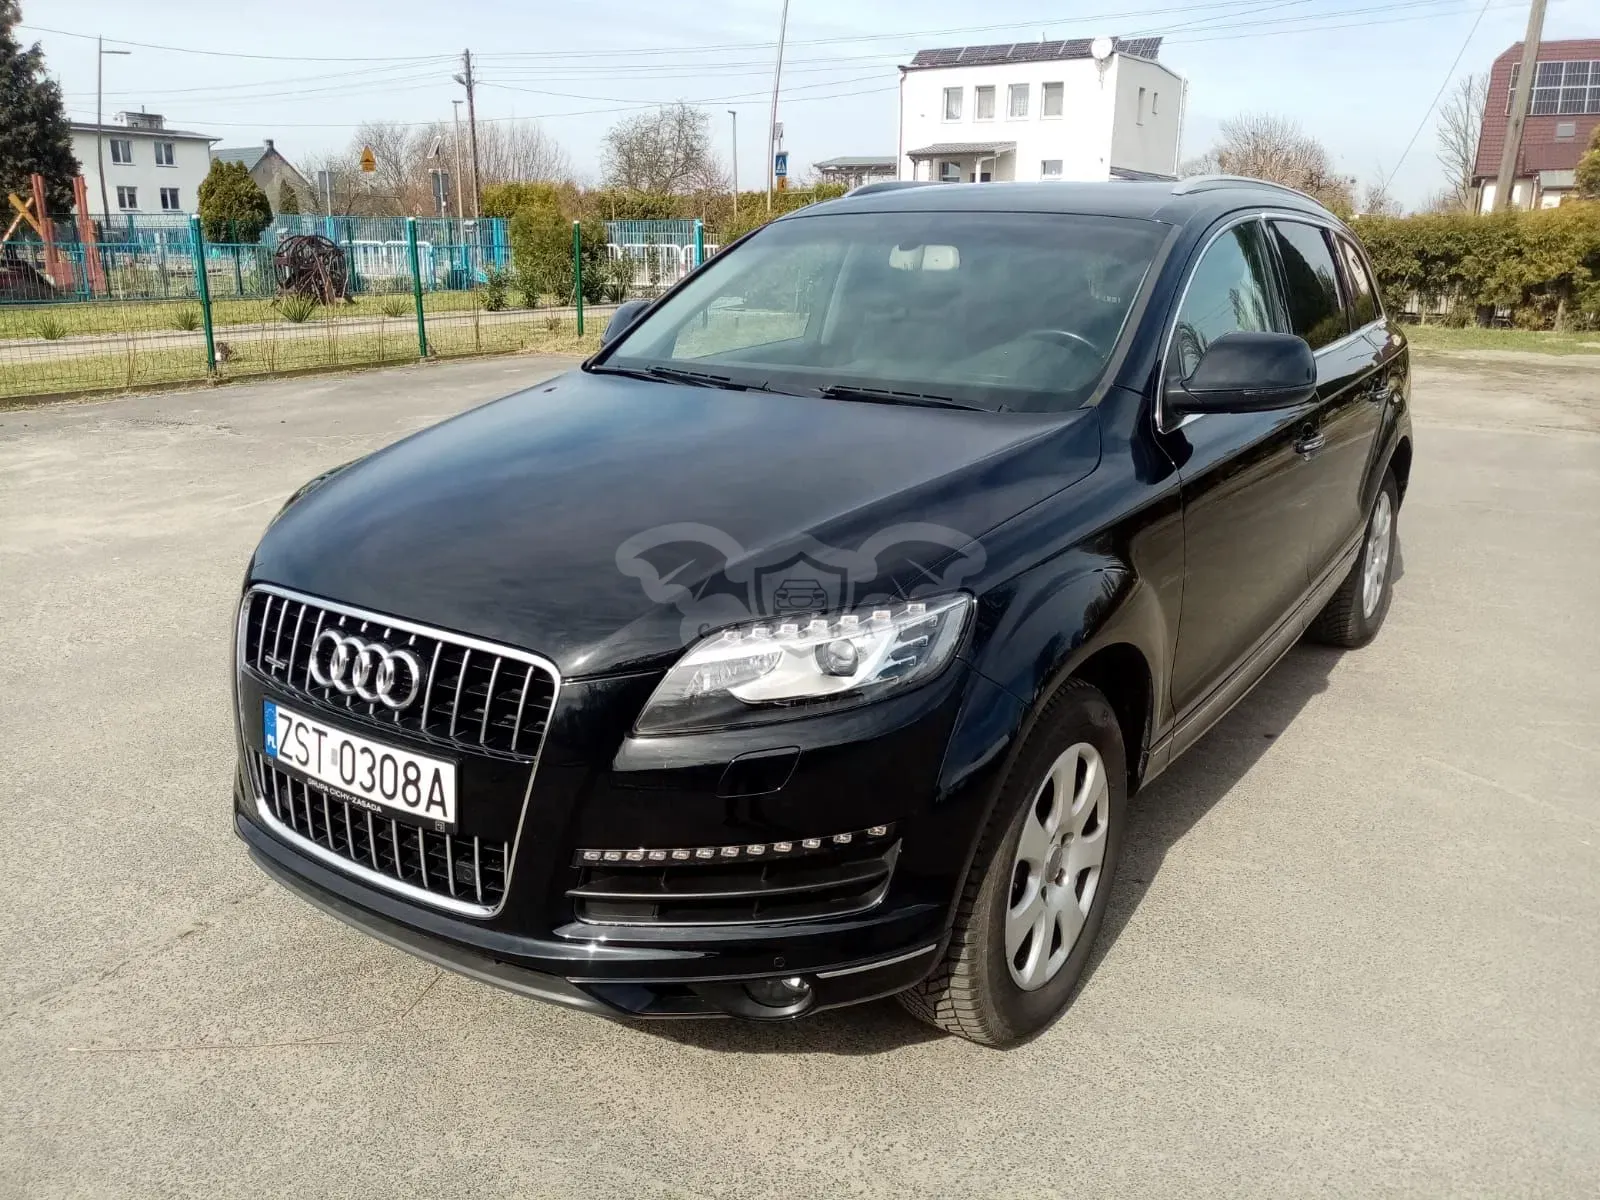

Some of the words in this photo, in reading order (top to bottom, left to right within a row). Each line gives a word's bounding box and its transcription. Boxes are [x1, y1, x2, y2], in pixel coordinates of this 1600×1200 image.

[267, 734, 276, 749] PL
[278, 712, 328, 774] ZST
[340, 740, 448, 817] 0308A
[307, 777, 329, 792] GRUPA
